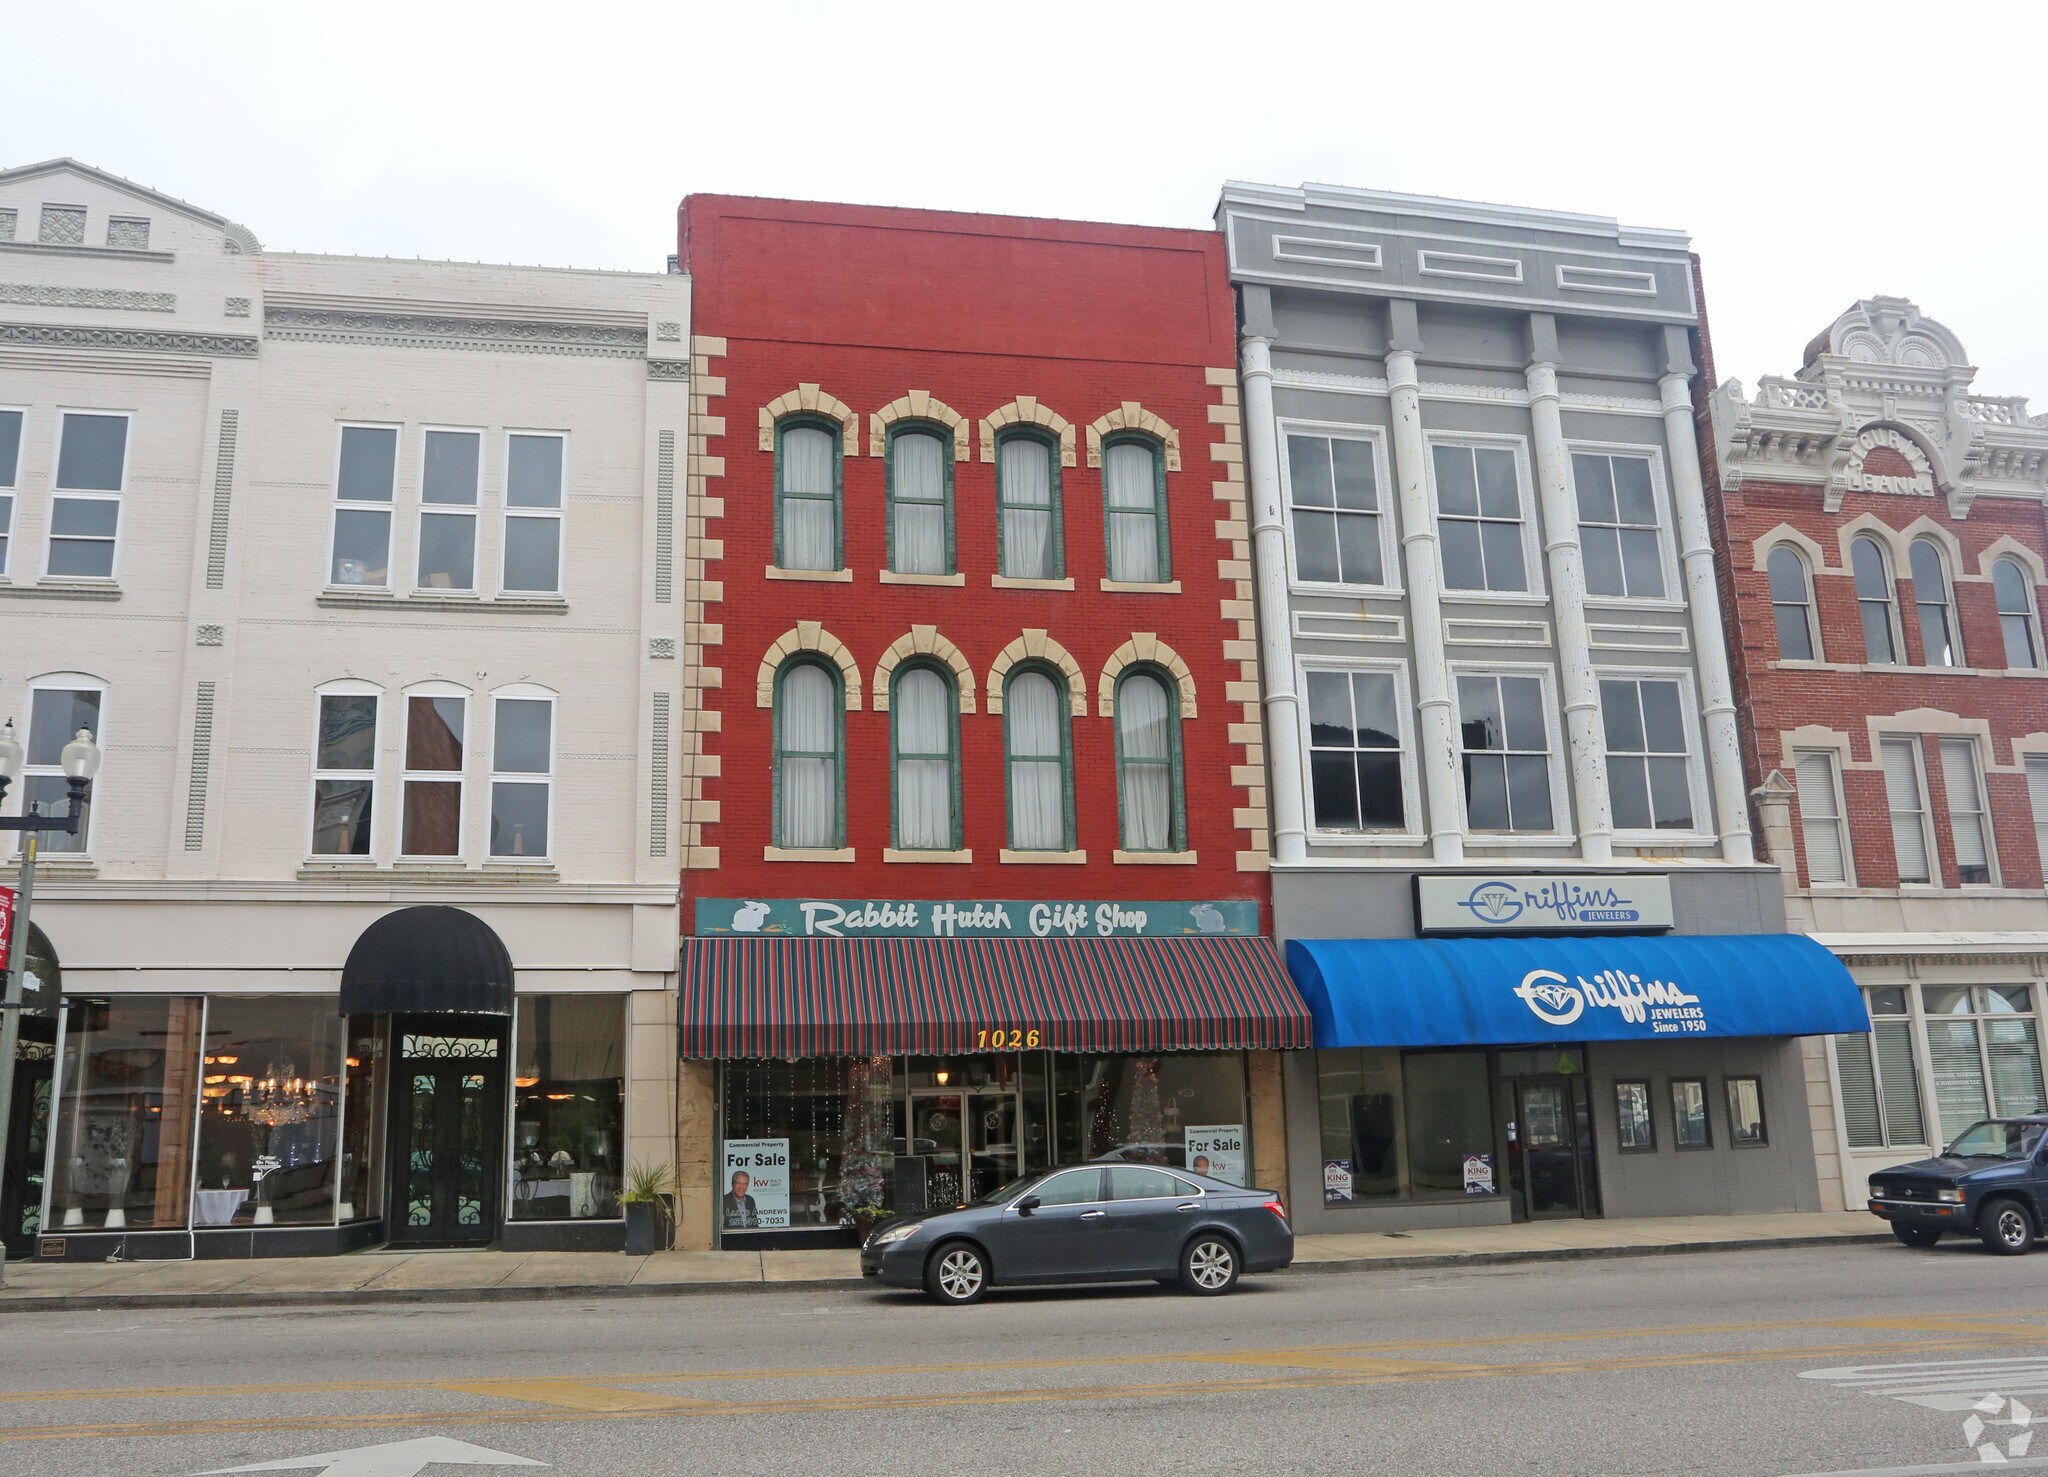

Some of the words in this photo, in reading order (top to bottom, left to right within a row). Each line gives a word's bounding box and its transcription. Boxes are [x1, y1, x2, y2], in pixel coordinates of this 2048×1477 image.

[1863, 473, 1921, 496] BANK
[1457, 881, 1632, 924] Griffins
[799, 902, 919, 937] Rabbit
[931, 903, 1012, 937] Hutch
[1029, 903, 1089, 937] Gift
[1095, 903, 1147, 937] Shop
[1588, 911, 1631, 920] JEWELERS
[1513, 969, 1700, 1025] Griffins
[1651, 1007, 1704, 1019] JEWELERS
[1653, 1020, 1679, 1033] Since
[1681, 1020, 1706, 1032] 1950
[977, 1029, 1040, 1048] 1026
[1189, 1139, 1209, 1152] For
[1213, 1138, 1241, 1151] Sale
[727, 1154, 750, 1167] For
[755, 1153, 786, 1166] Sale
[1212, 1161, 1227, 1171] kw
[1467, 1167, 1488, 1175] KING
[753, 1177, 769, 1187] kw
[752, 1208, 788, 1216] ANDREWS
